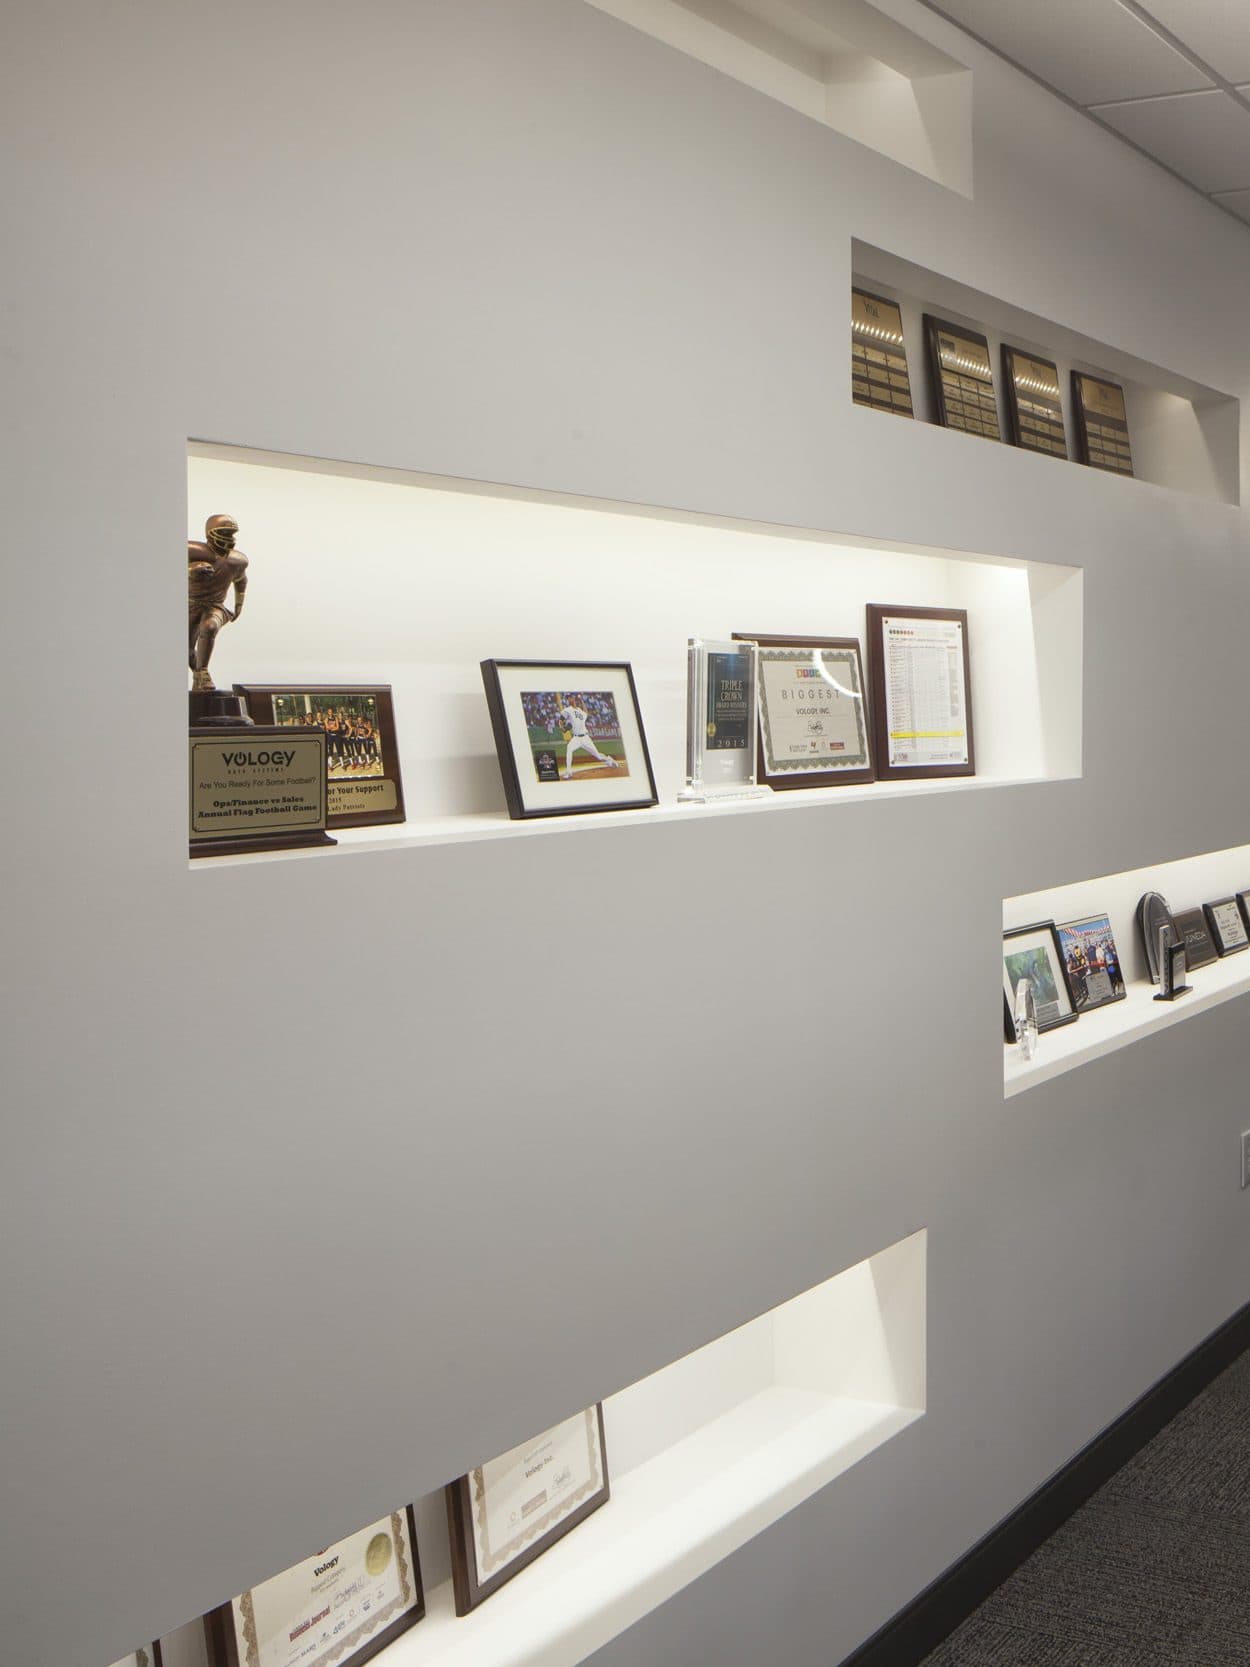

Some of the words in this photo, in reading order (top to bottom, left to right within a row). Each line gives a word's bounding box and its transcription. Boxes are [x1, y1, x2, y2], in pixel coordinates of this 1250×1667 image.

[720, 680, 743, 691] TRIPLE
[781, 689, 839, 700] BIGGEST
[221, 750, 296, 767] VOLOGY
[213, 781, 227, 789] You
[228, 780, 251, 789] Ready
[266, 778, 286, 786] Some
[337, 786, 354, 794] Your
[355, 785, 384, 795] Support
[198, 809, 232, 818] Annual
[233, 808, 253, 816] Flag
[255, 805, 291, 815] Football
[313, 1555, 339, 1577] Vology
